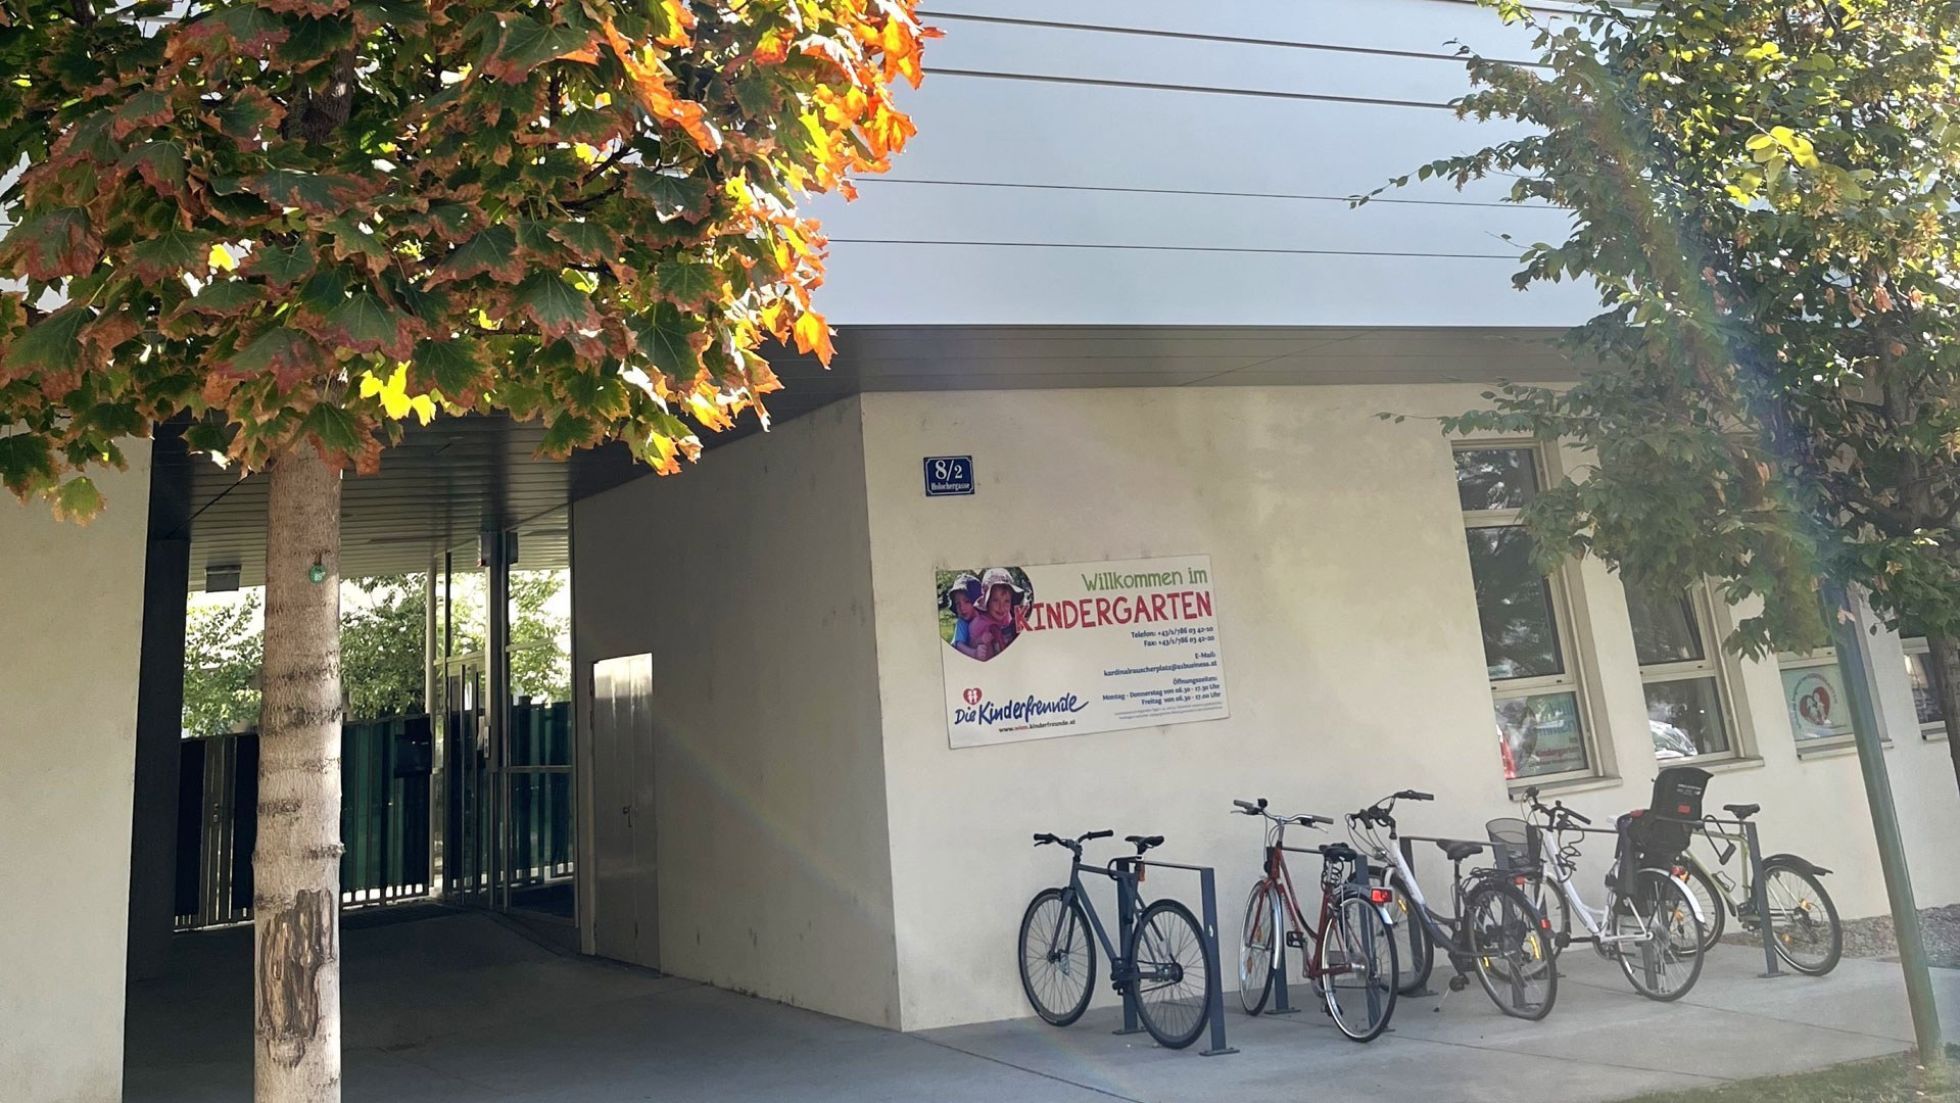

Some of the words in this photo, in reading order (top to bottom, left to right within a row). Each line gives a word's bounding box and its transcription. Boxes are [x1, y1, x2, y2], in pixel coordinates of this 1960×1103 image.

[935, 460, 963, 481] 8/2
[1081, 570, 1183, 592] Willkommen
[1187, 567, 1208, 585] im
[1014, 590, 1213, 633] KINDERGARTEN
[1131, 630, 1157, 639] Telefon:
[1144, 639, 1157, 647] Fax:
[1102, 693, 1126, 701] Montag
[1129, 688, 1163, 699] Donnerstag
[1141, 697, 1162, 705] Freitag
[954, 706, 977, 725] Die
[979, 692, 1089, 725] Kinderfreunde
